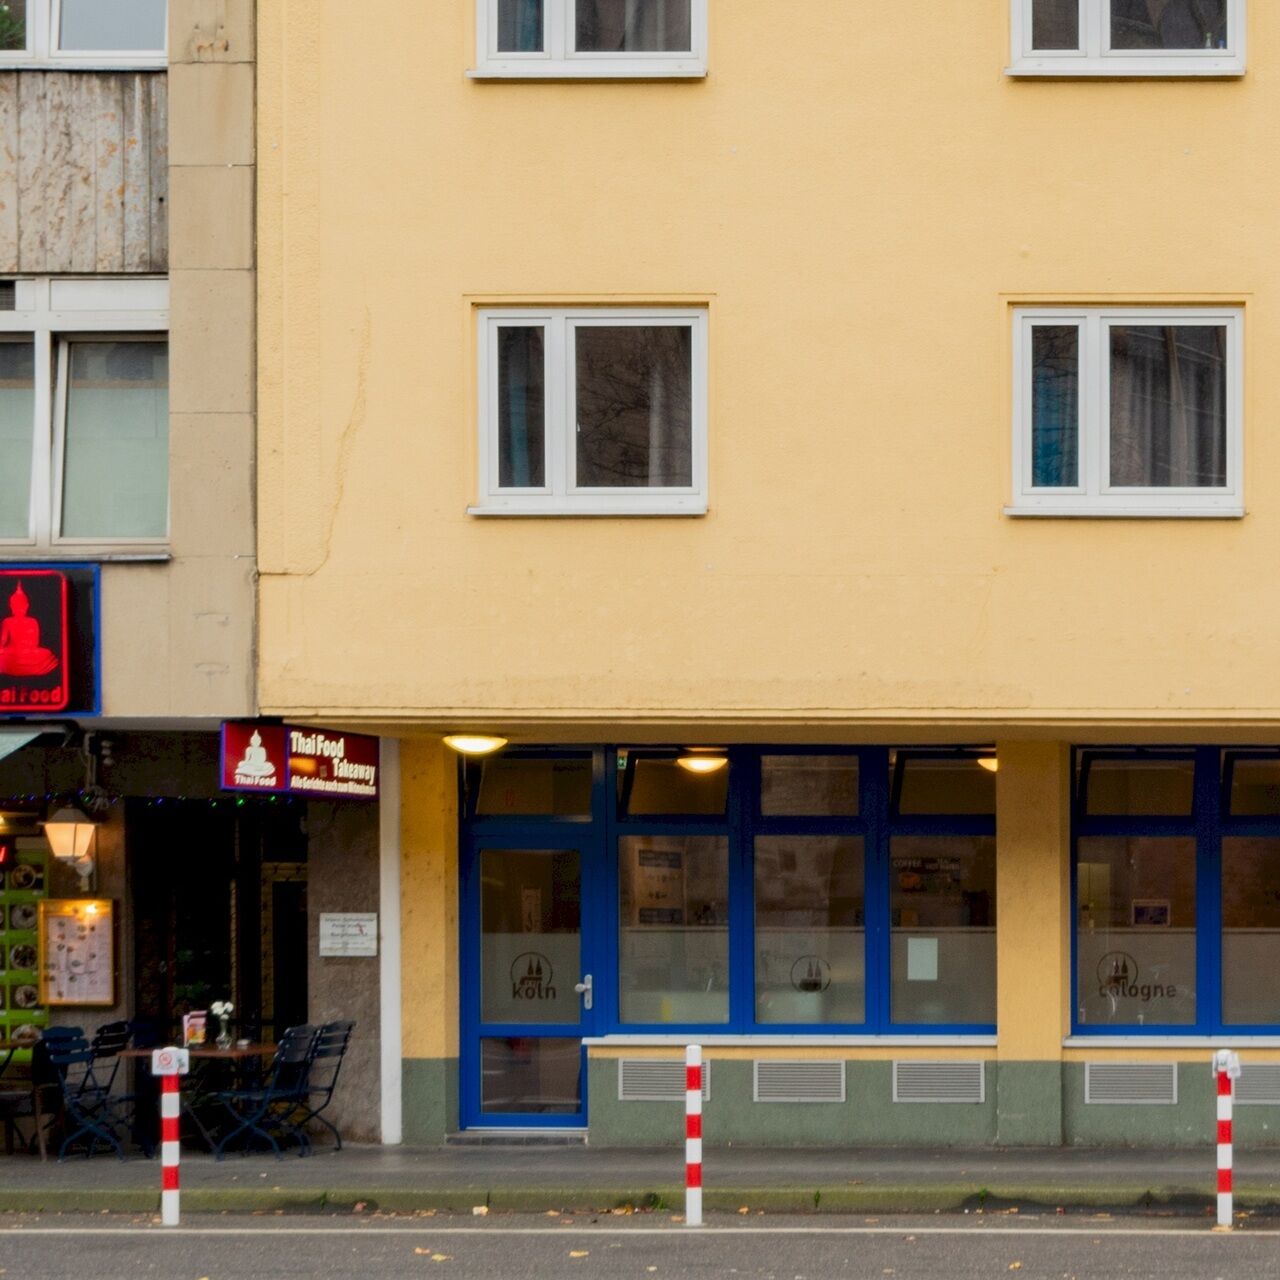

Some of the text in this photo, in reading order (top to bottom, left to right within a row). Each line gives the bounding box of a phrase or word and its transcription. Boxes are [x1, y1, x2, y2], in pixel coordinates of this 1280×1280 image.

[290, 731, 345, 758] Thai Food
[235, 775, 277, 787] Thai Food
[333, 758, 375, 785] Takeaway
[1099, 980, 1177, 1002] cologne
